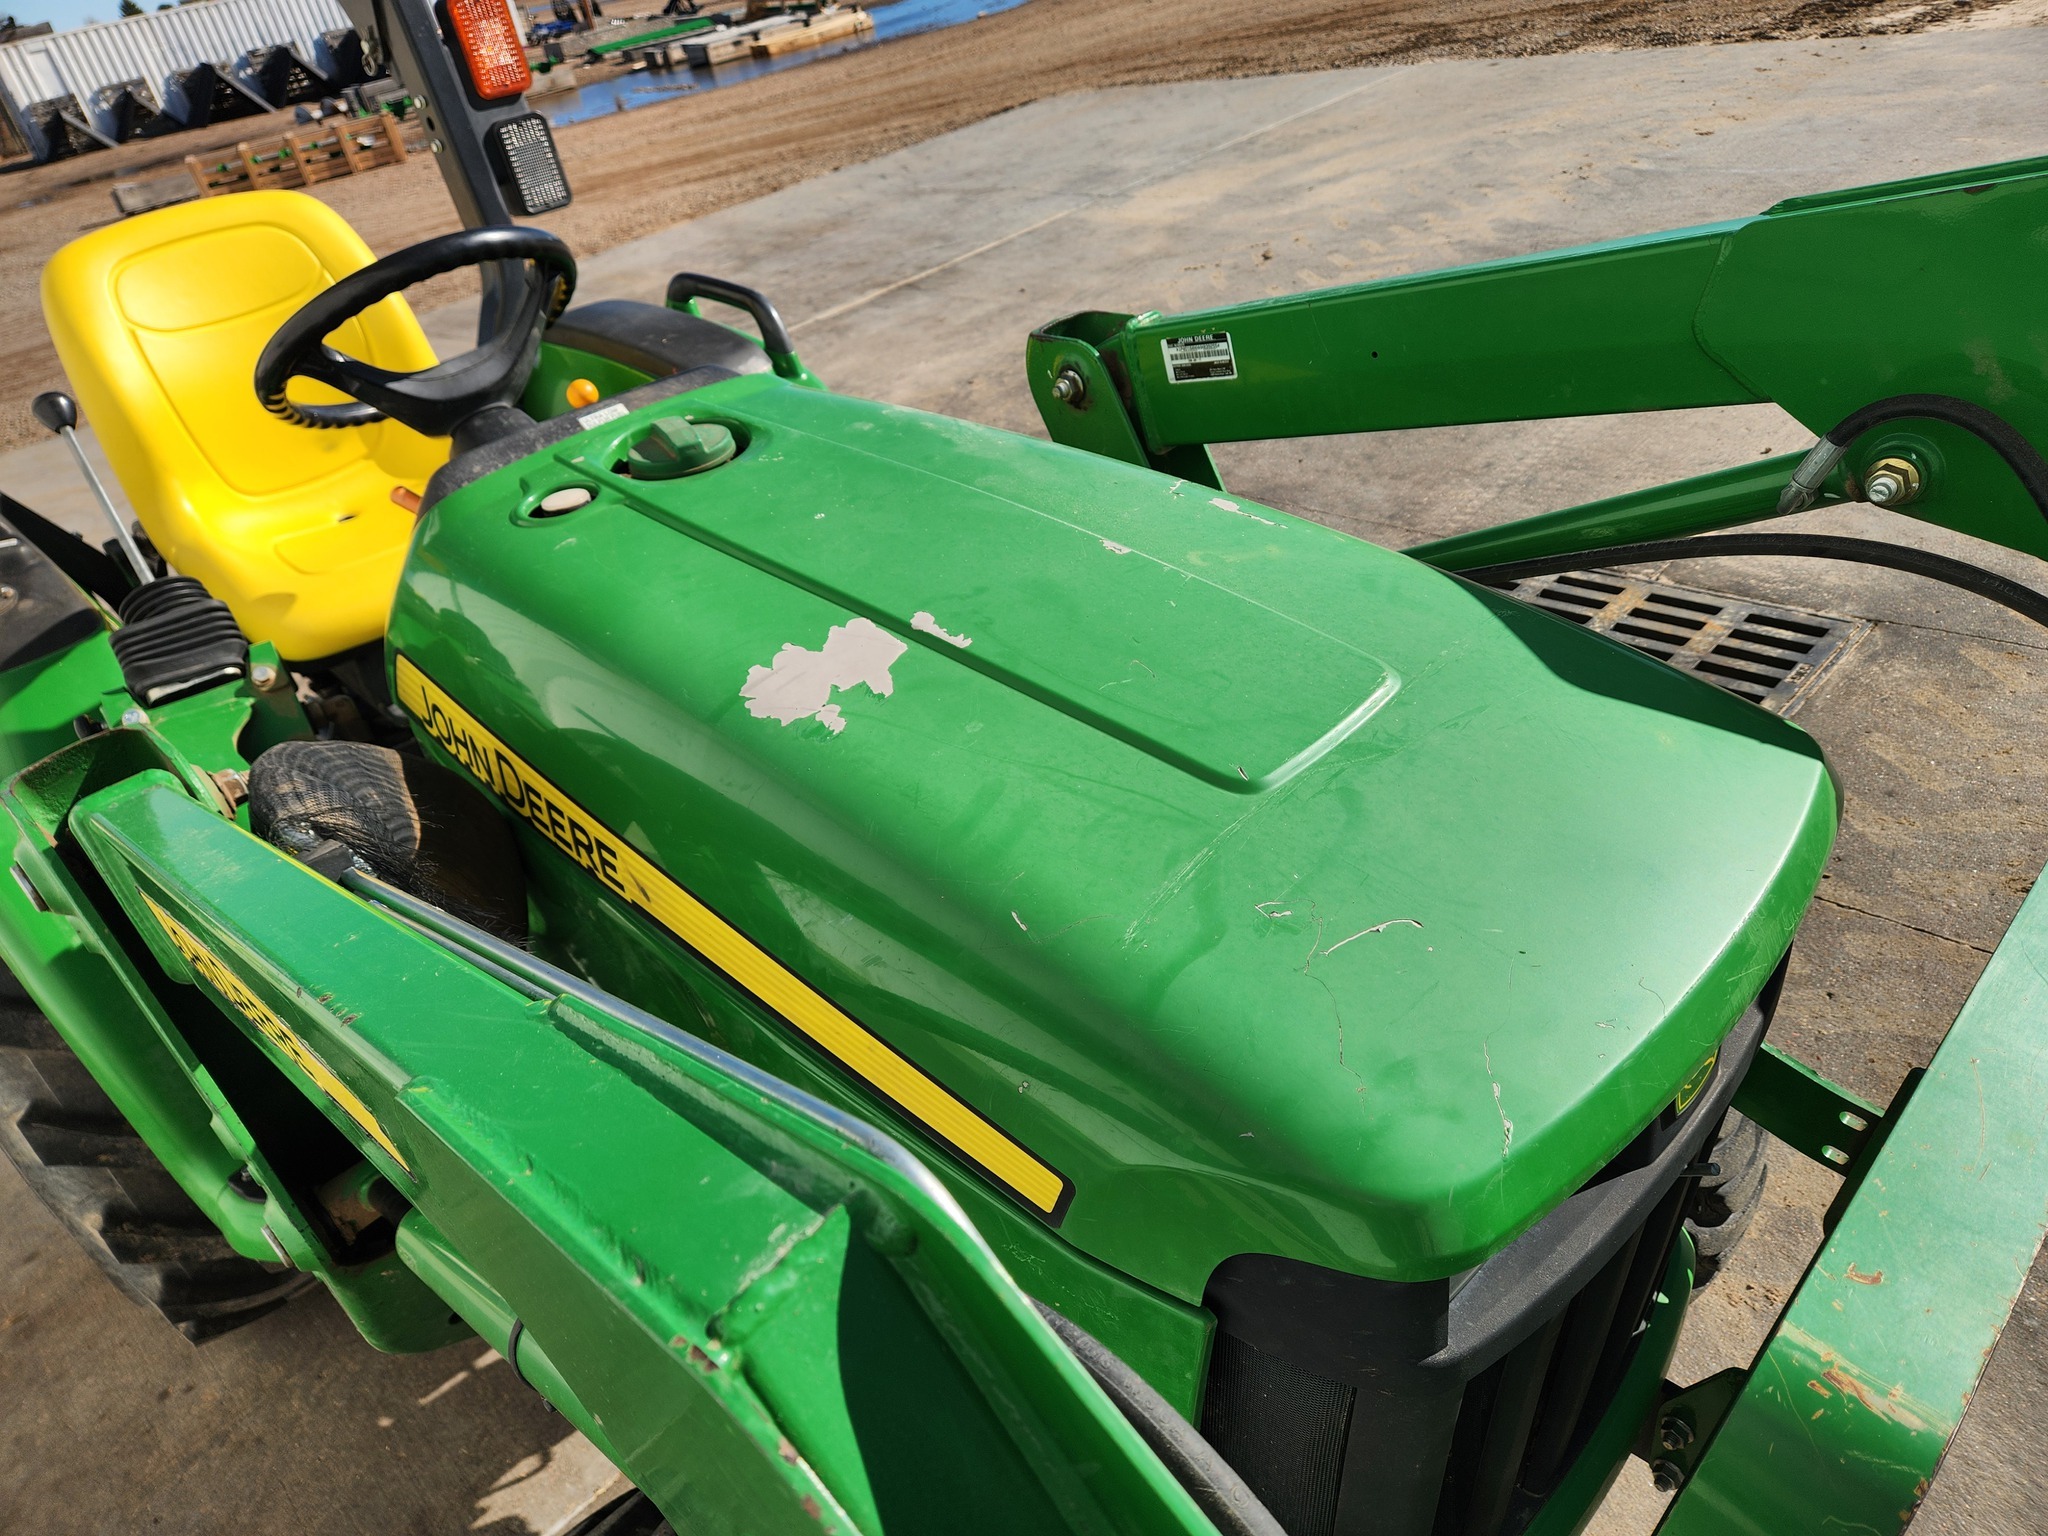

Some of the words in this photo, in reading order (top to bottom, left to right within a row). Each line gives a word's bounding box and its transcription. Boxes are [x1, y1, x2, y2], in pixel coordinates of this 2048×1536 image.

[1177, 336, 1194, 344] JOHN
[1194, 334, 1214, 342] DEERE
[421, 685, 495, 786] JOHN
[494, 746, 626, 893] DEERE
